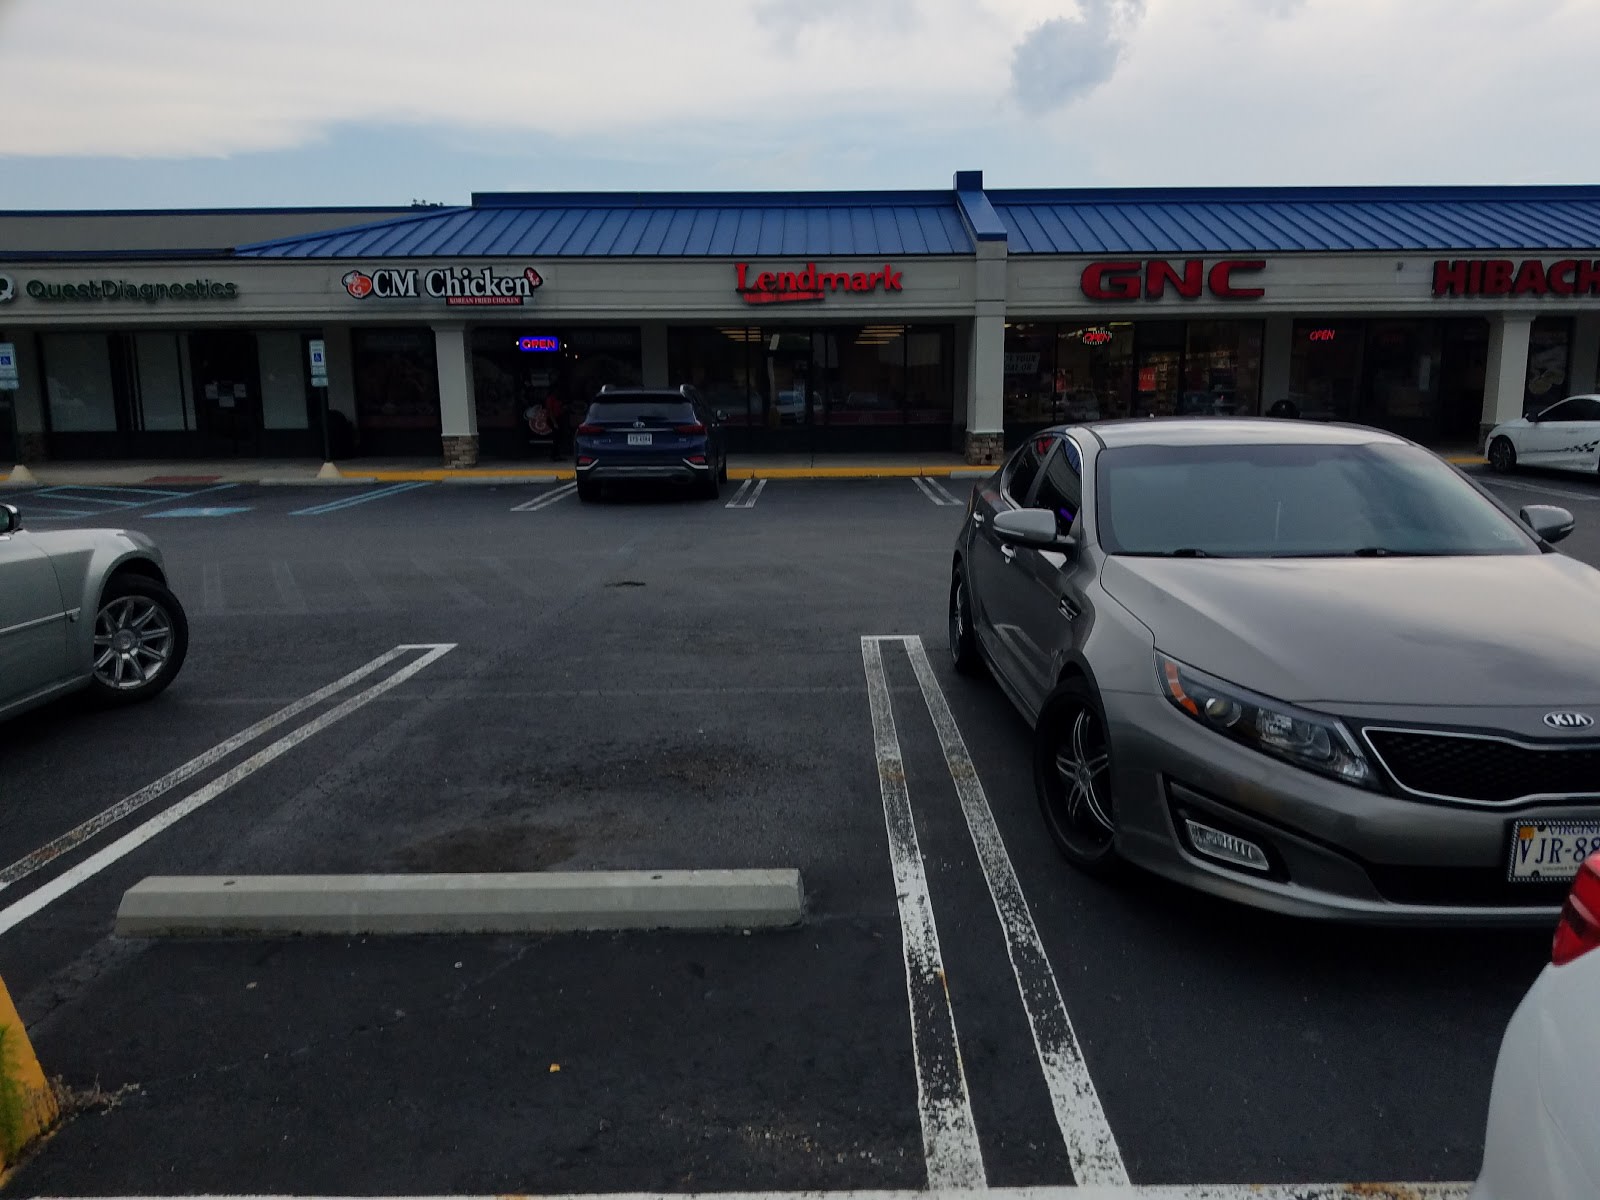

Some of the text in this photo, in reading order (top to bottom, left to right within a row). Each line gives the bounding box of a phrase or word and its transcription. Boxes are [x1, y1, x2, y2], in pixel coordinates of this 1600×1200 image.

[372, 269, 418, 297] CM
[425, 268, 532, 297] Chicken
[735, 262, 903, 292] Lendmark
[1080, 260, 1267, 299] GNC
[1432, 259, 1600, 296] HIBACH
[26, 279, 238, 304] Quest Diagnostics
[521, 338, 556, 350] OPEN
[1309, 329, 1335, 341] OPEN
[1551, 713, 1588, 726] KIA
